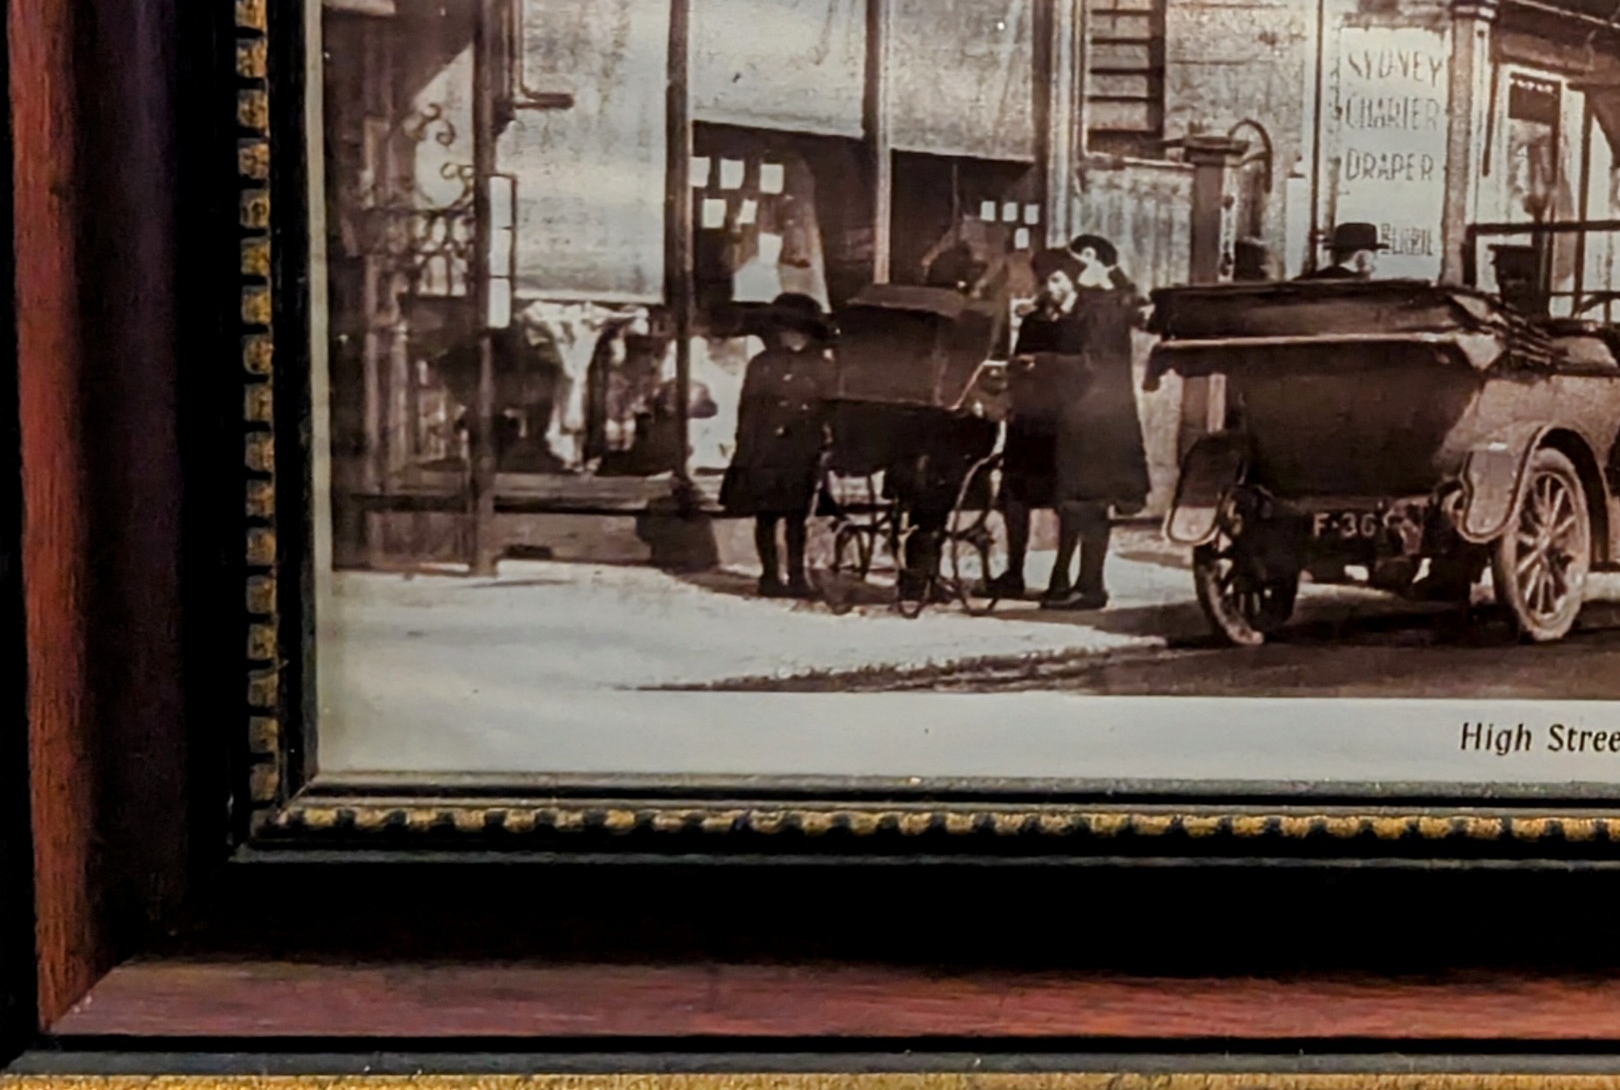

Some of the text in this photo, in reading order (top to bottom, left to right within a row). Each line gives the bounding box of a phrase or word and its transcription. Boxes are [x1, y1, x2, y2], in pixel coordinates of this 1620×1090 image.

[1347, 48, 1443, 88] SYDNEY
[1345, 147, 1435, 182] DRAPER
[1460, 721, 1532, 756] High
